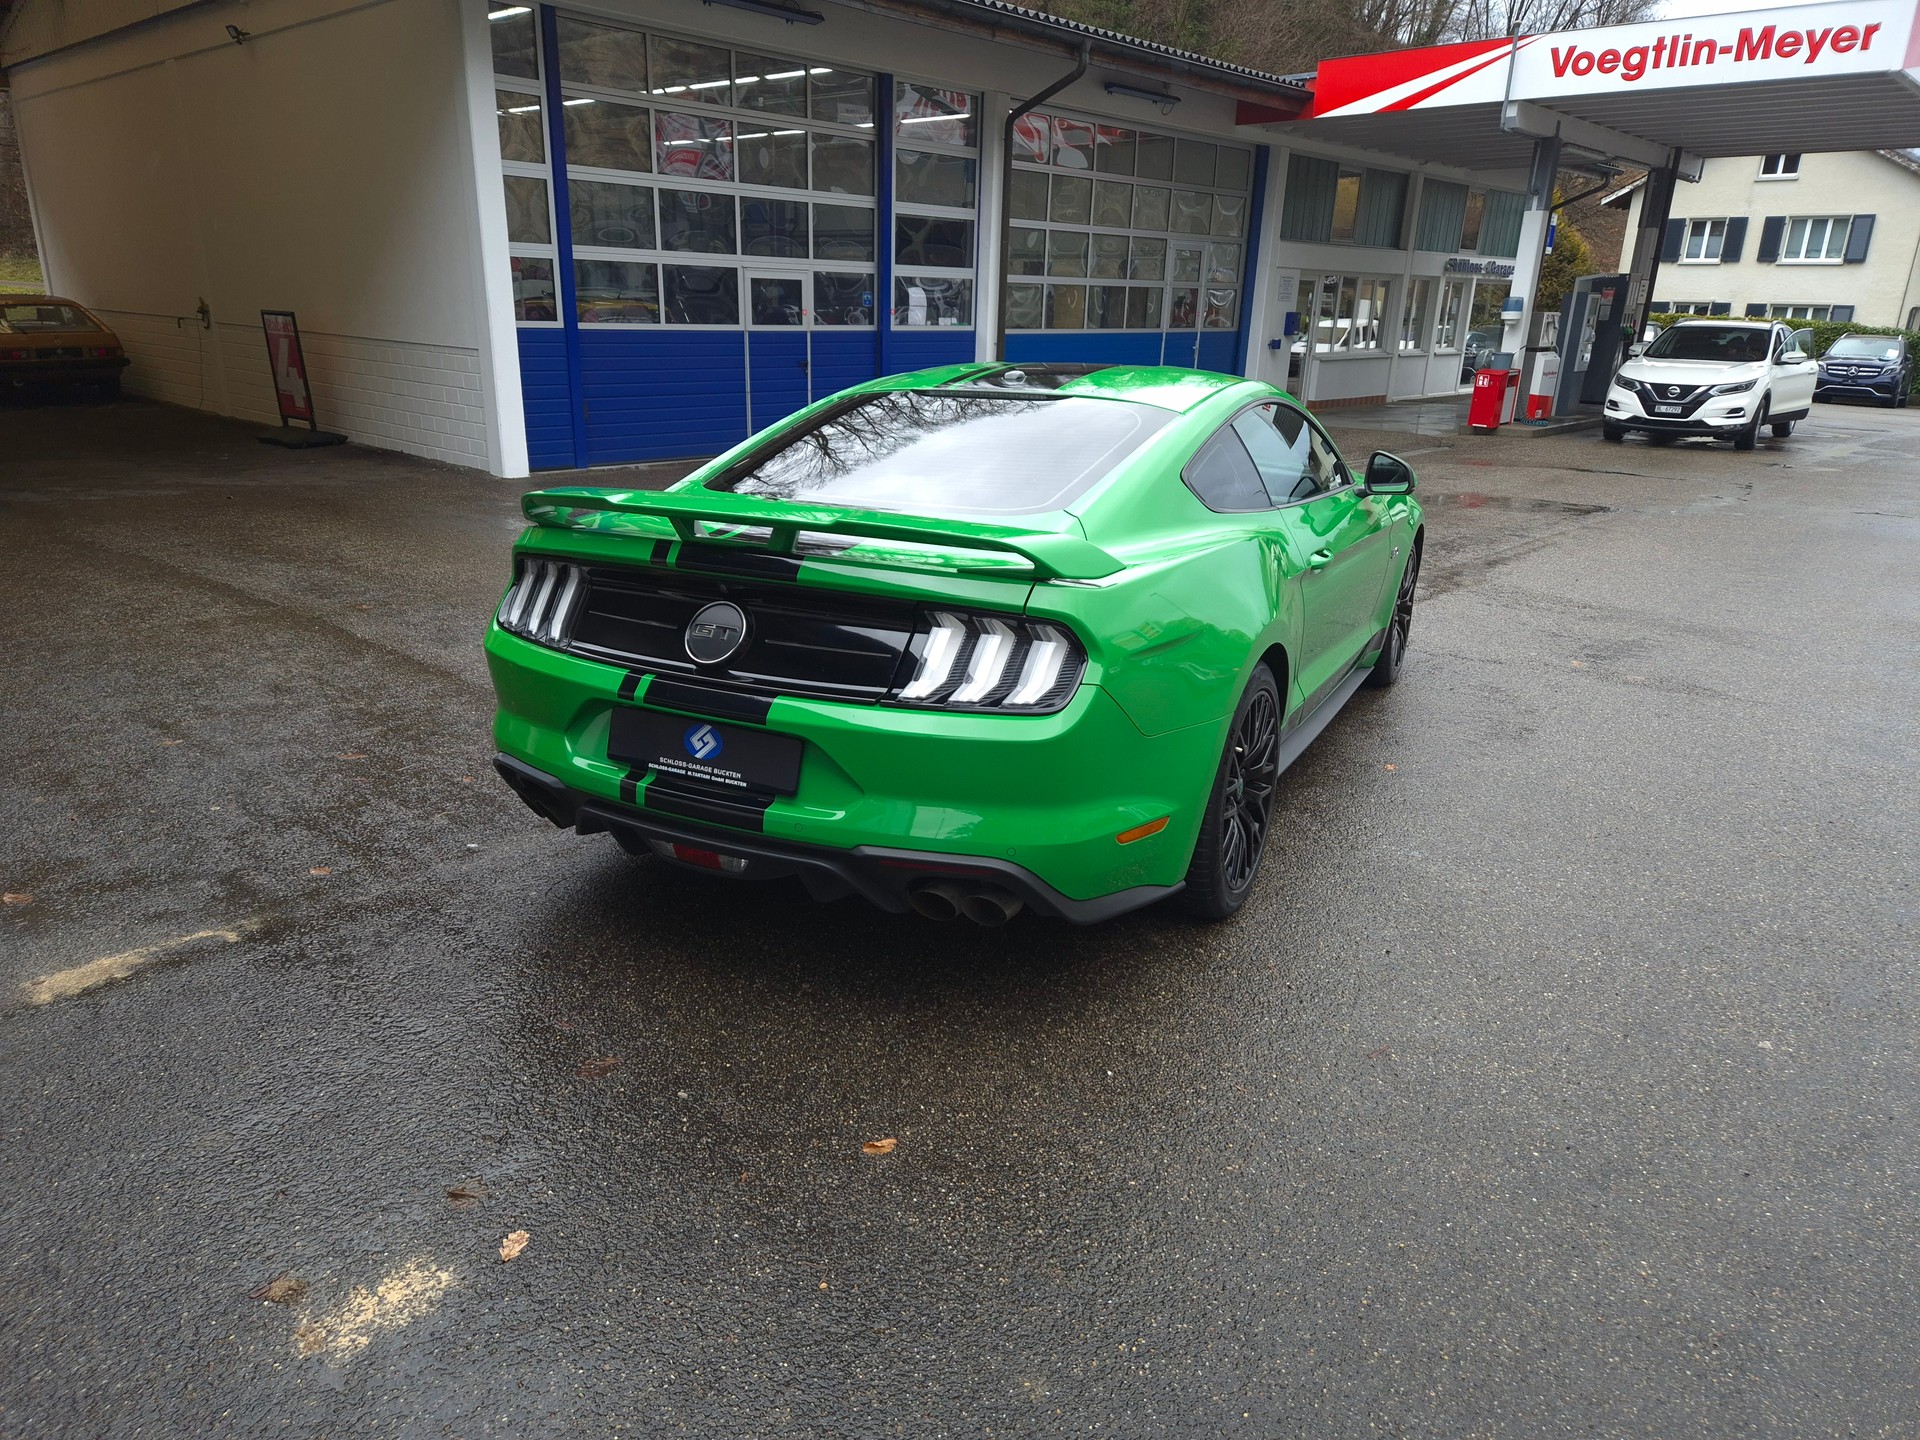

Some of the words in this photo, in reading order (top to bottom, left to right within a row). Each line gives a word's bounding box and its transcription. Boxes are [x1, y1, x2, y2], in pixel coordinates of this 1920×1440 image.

[1550, 21, 1882, 82] Voegtlin-Meyer
[692, 622, 739, 640] GT
[648, 762, 686, 775] SCHLOSS-GARAGE
[725, 778, 747, 788] BUCKTEN
[659, 756, 713, 773] SCHLOSS-GARAGE
[713, 767, 742, 779] BUCKTEN
